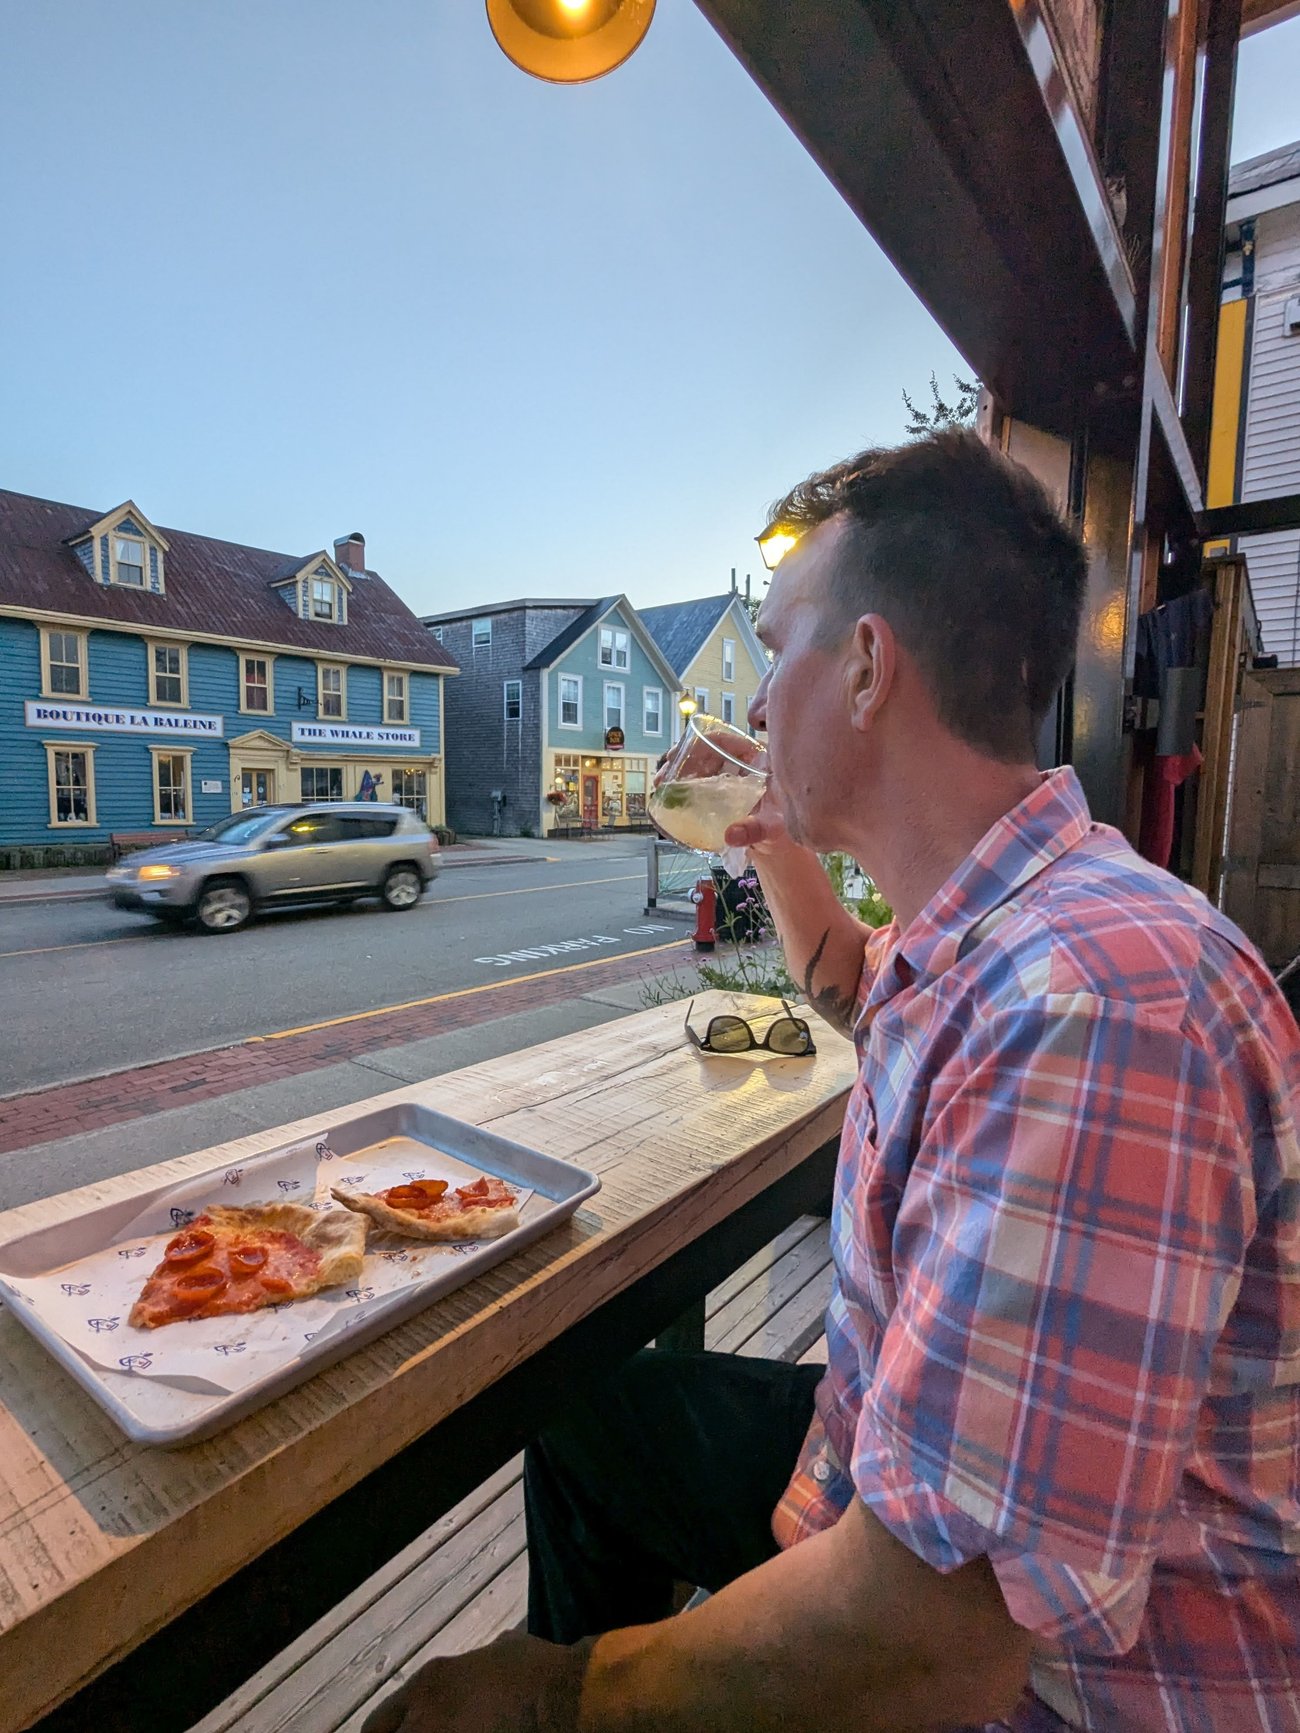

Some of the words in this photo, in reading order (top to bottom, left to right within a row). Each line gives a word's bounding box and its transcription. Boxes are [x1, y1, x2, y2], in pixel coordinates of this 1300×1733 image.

[36, 708, 125, 725] BOUTIQUE
[130, 715, 149, 727] LA
[153, 717, 217, 730] BALEINE
[298, 727, 327, 737] THE
[330, 729, 374, 740] WHALE
[377, 732, 415, 742] STORE
[623, 923, 675, 935] NO
[473, 935, 621, 966] PARKING
